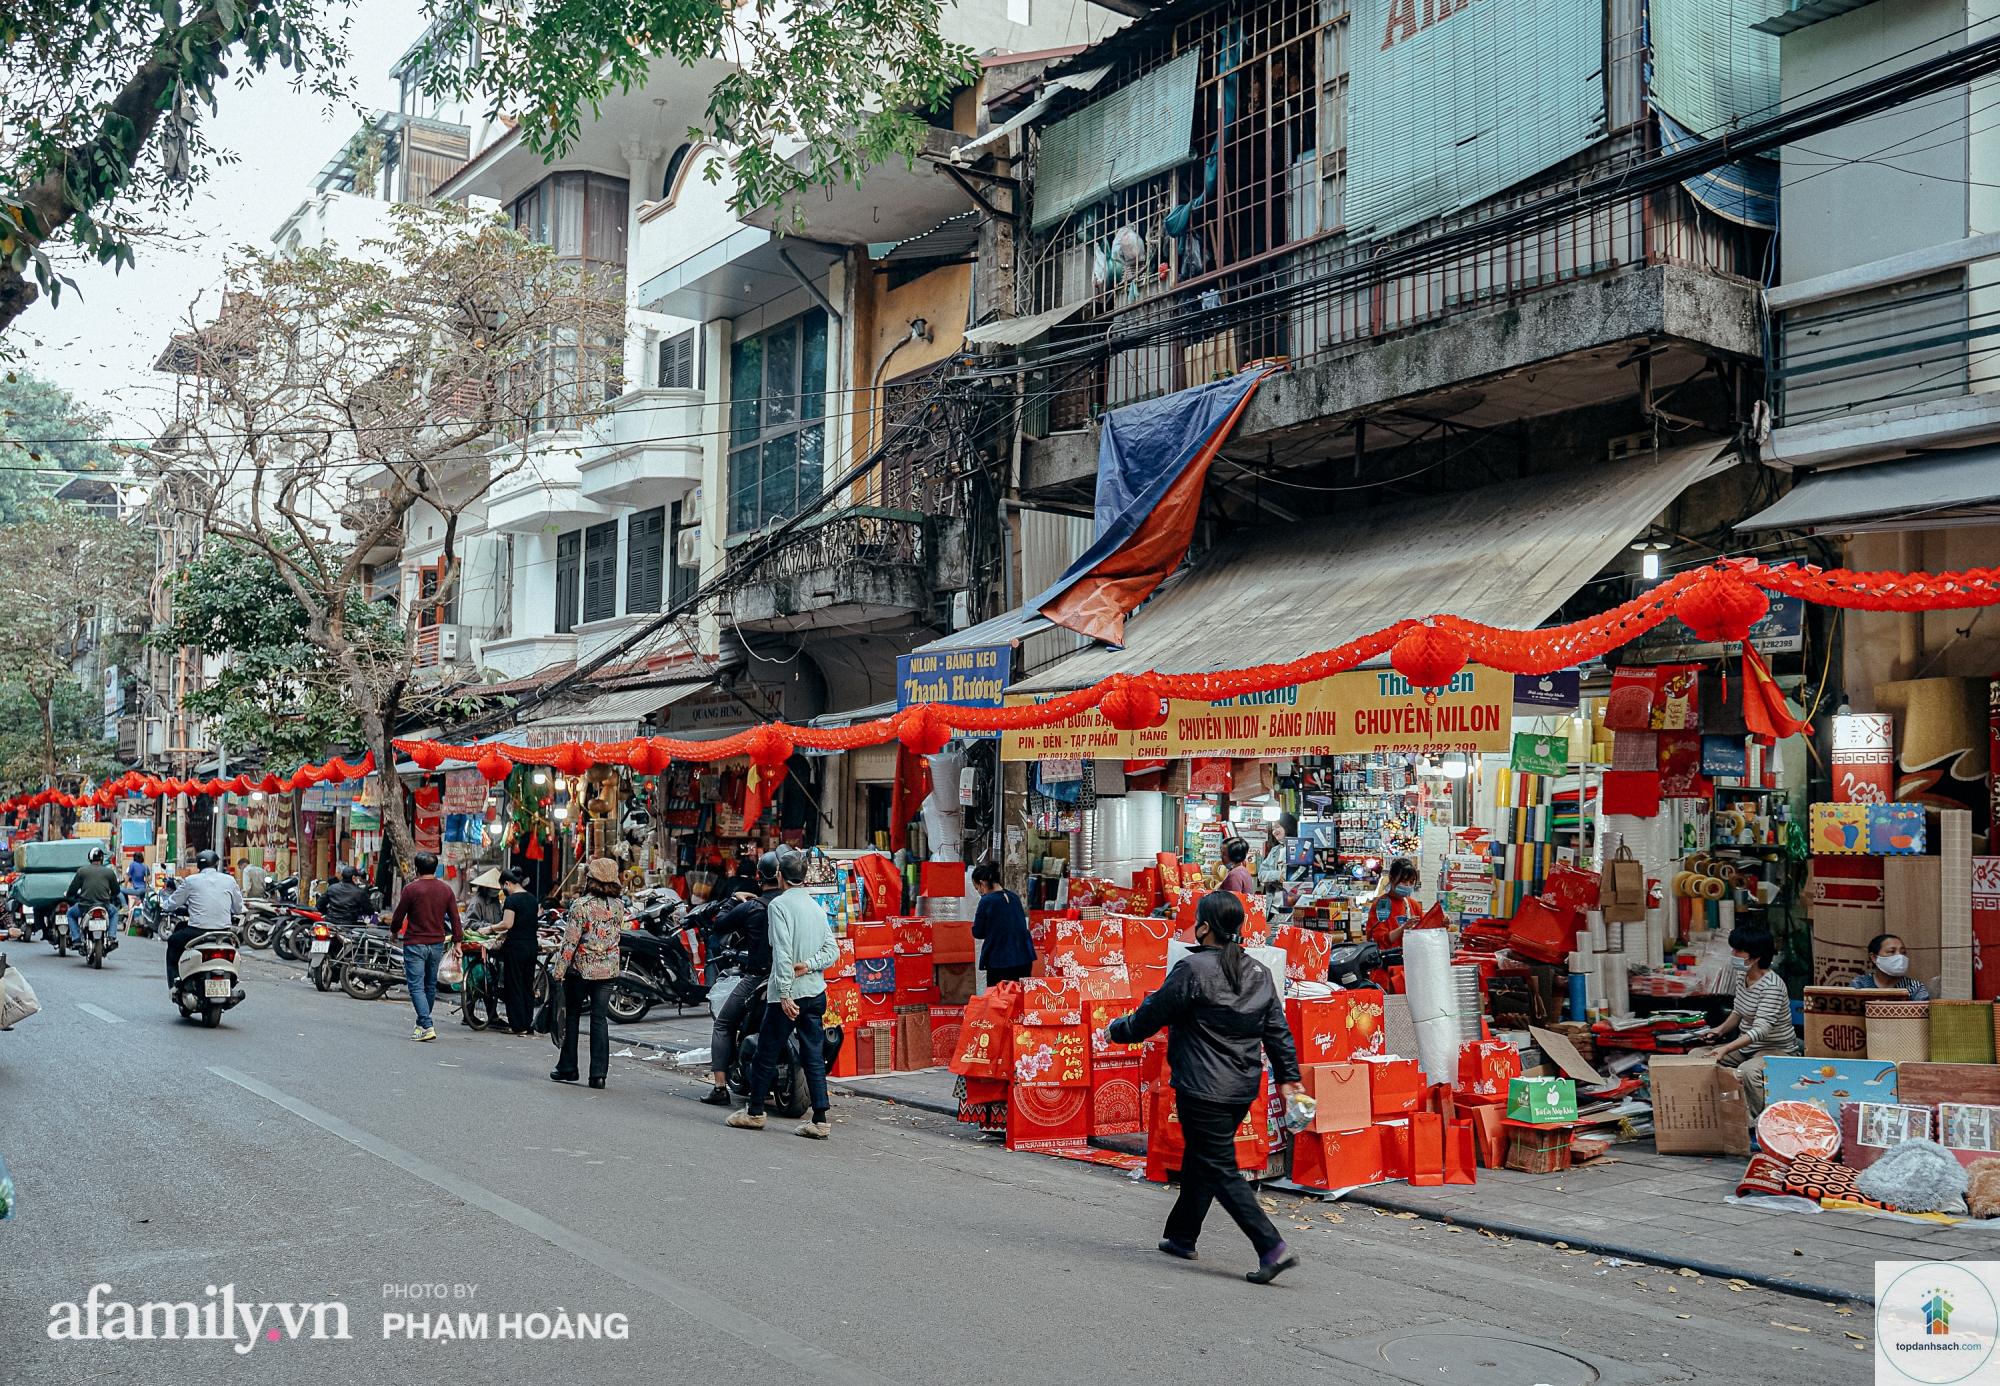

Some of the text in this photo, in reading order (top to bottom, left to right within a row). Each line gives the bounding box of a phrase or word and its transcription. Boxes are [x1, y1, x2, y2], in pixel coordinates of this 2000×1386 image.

[910, 656, 937, 673] NILON
[946, 651, 973, 670] BĂNG
[976, 651, 997, 668] KEO
[904, 675, 1003, 705] Thanh Hương
[692, 706, 718, 721] QUANG
[1355, 703, 1500, 735] CHUYÊN NILON
[1178, 713, 1221, 740] CHUYÊN
[1224, 715, 1259, 740] NILON
[1269, 708, 1302, 738] BĂNG
[1305, 706, 1336, 736] DÍNH
[1018, 737, 1034, 749] PIN
[1140, 729, 1168, 740] HÀNG
[1138, 744, 1168, 757] CHIẾU
